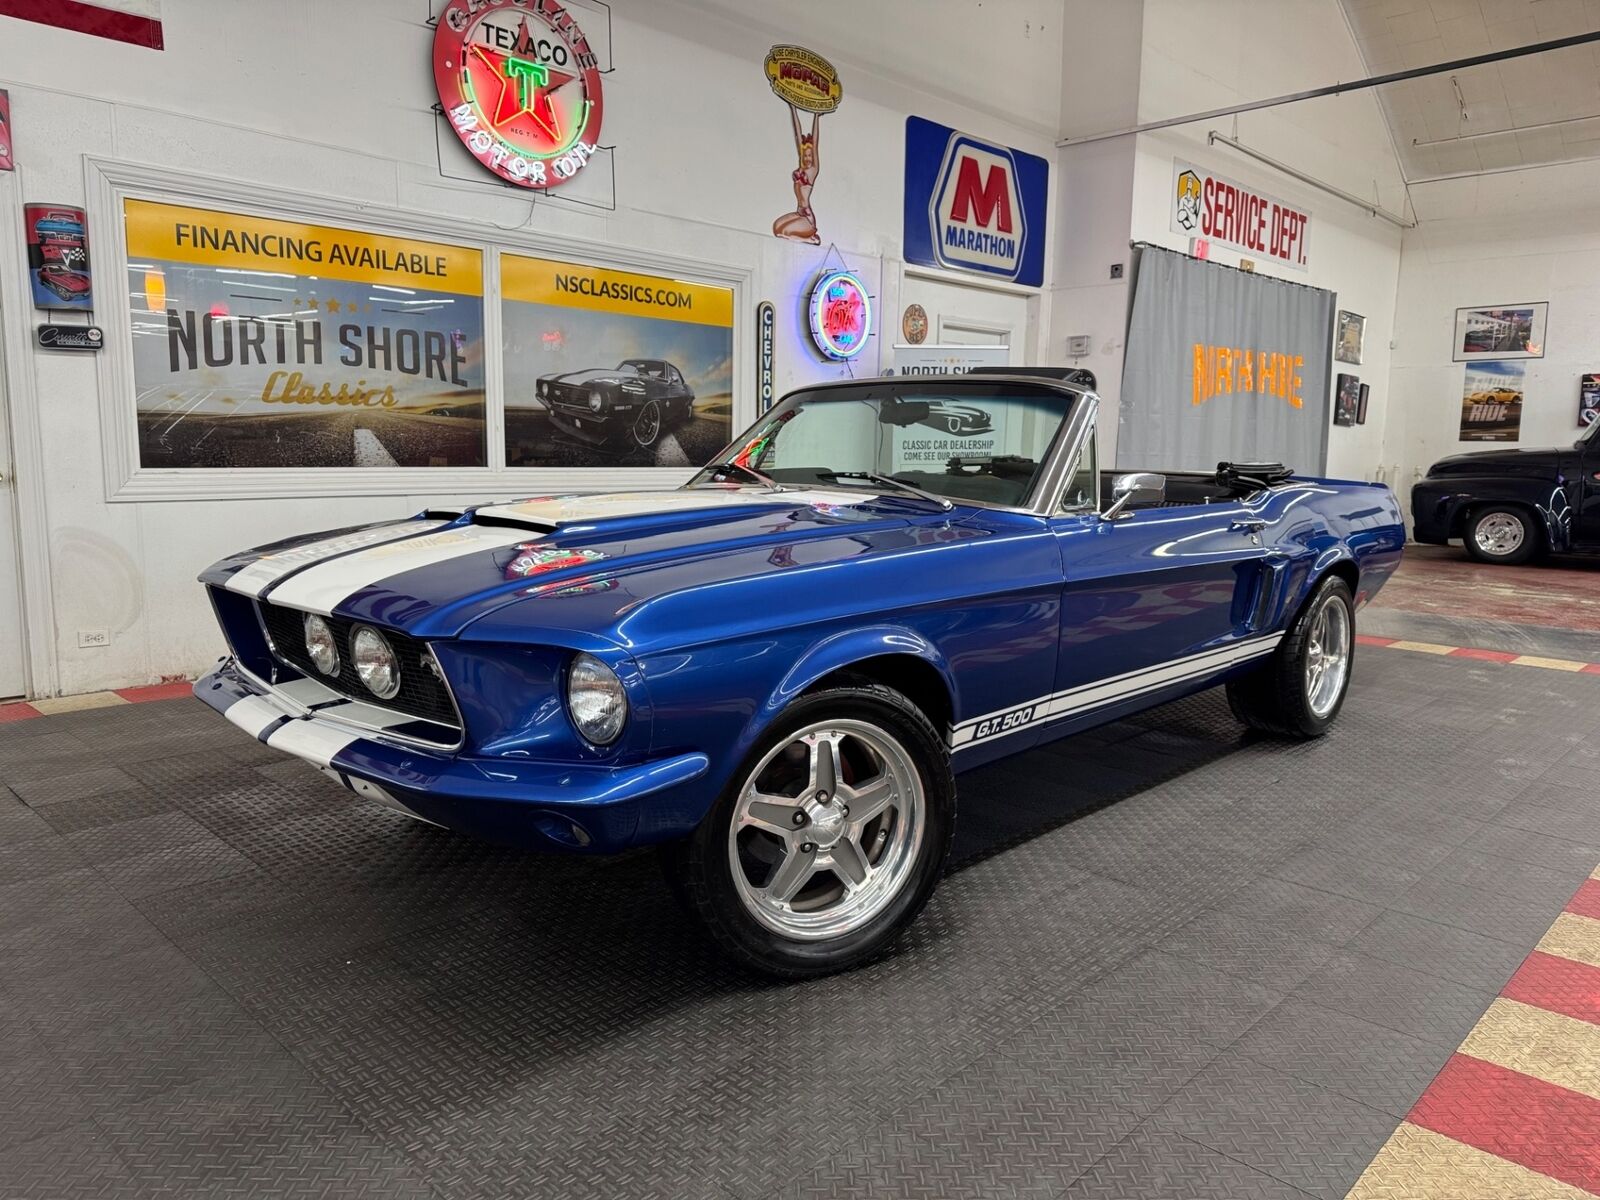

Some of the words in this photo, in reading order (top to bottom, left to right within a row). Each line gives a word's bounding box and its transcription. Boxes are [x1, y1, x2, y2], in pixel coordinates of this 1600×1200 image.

[481, 22, 568, 66] TEXACO
[450, 103, 547, 185] MOTOR
[552, 141, 597, 179] OIL
[950, 155, 1013, 234] M
[1202, 177, 1268, 252] SERVICE
[1269, 204, 1307, 265] DEPT.
[175, 223, 323, 263] FINANCING
[328, 243, 448, 277] AVAILABLE
[945, 225, 1015, 259] MARATHON
[555, 273, 692, 309] NSCLASSICS.COM
[167, 308, 323, 373] NORTH
[339, 324, 469, 388] SHORE
[261, 370, 400, 409] Classics
[1469, 404, 1508, 421] RIDE
[902, 440, 932, 450] CLASSIC
[933, 440, 948, 450] CAR
[950, 440, 994, 450] DEALERSHIP
[903, 452, 921, 460] COME
[923, 452, 936, 460] SEE
[937, 452, 951, 460] OUR
